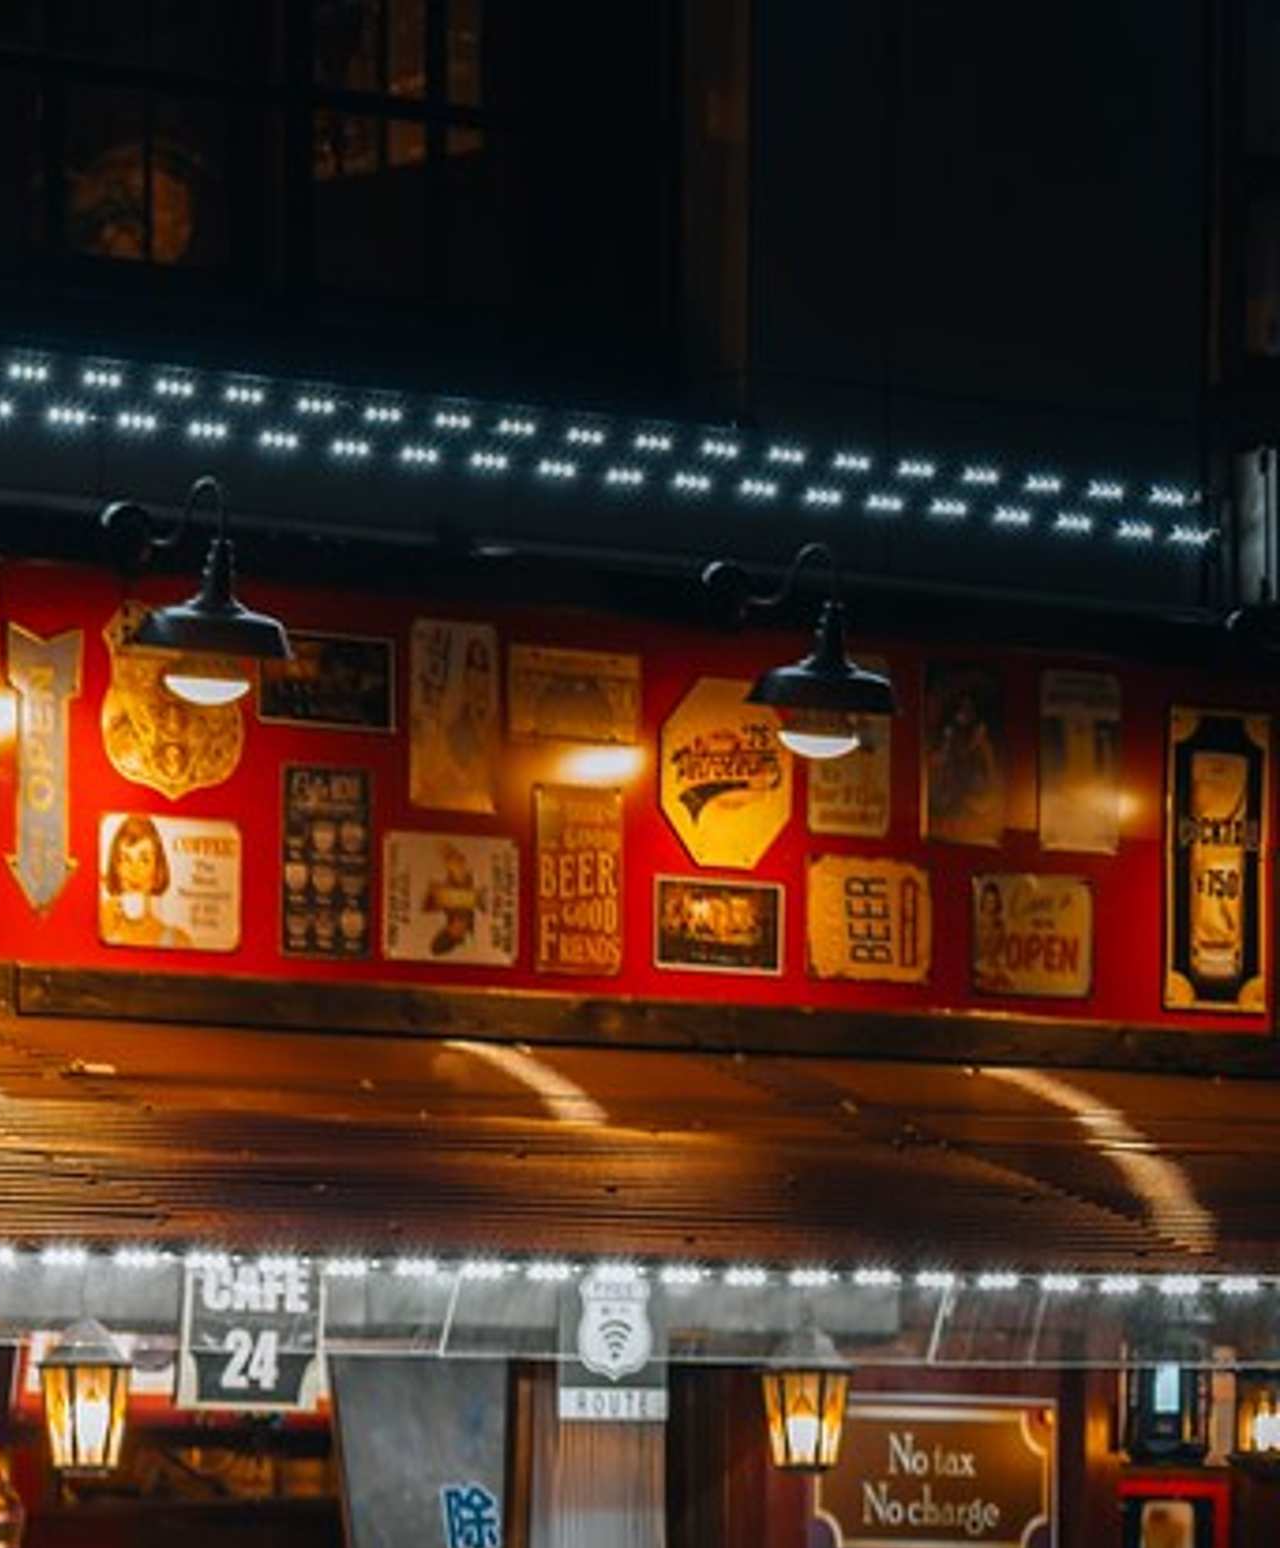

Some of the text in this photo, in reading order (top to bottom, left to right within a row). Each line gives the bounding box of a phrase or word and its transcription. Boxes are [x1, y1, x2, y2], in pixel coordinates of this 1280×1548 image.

[541, 851, 617, 897] BEER
[845, 875, 893, 964] BEER
[1006, 933, 1079, 974] OPEN
[203, 1258, 308, 1313] CAFE
[220, 1329, 278, 1391] 24
[889, 1432, 977, 1477] No tax
[862, 1481, 1000, 1534] No charge
